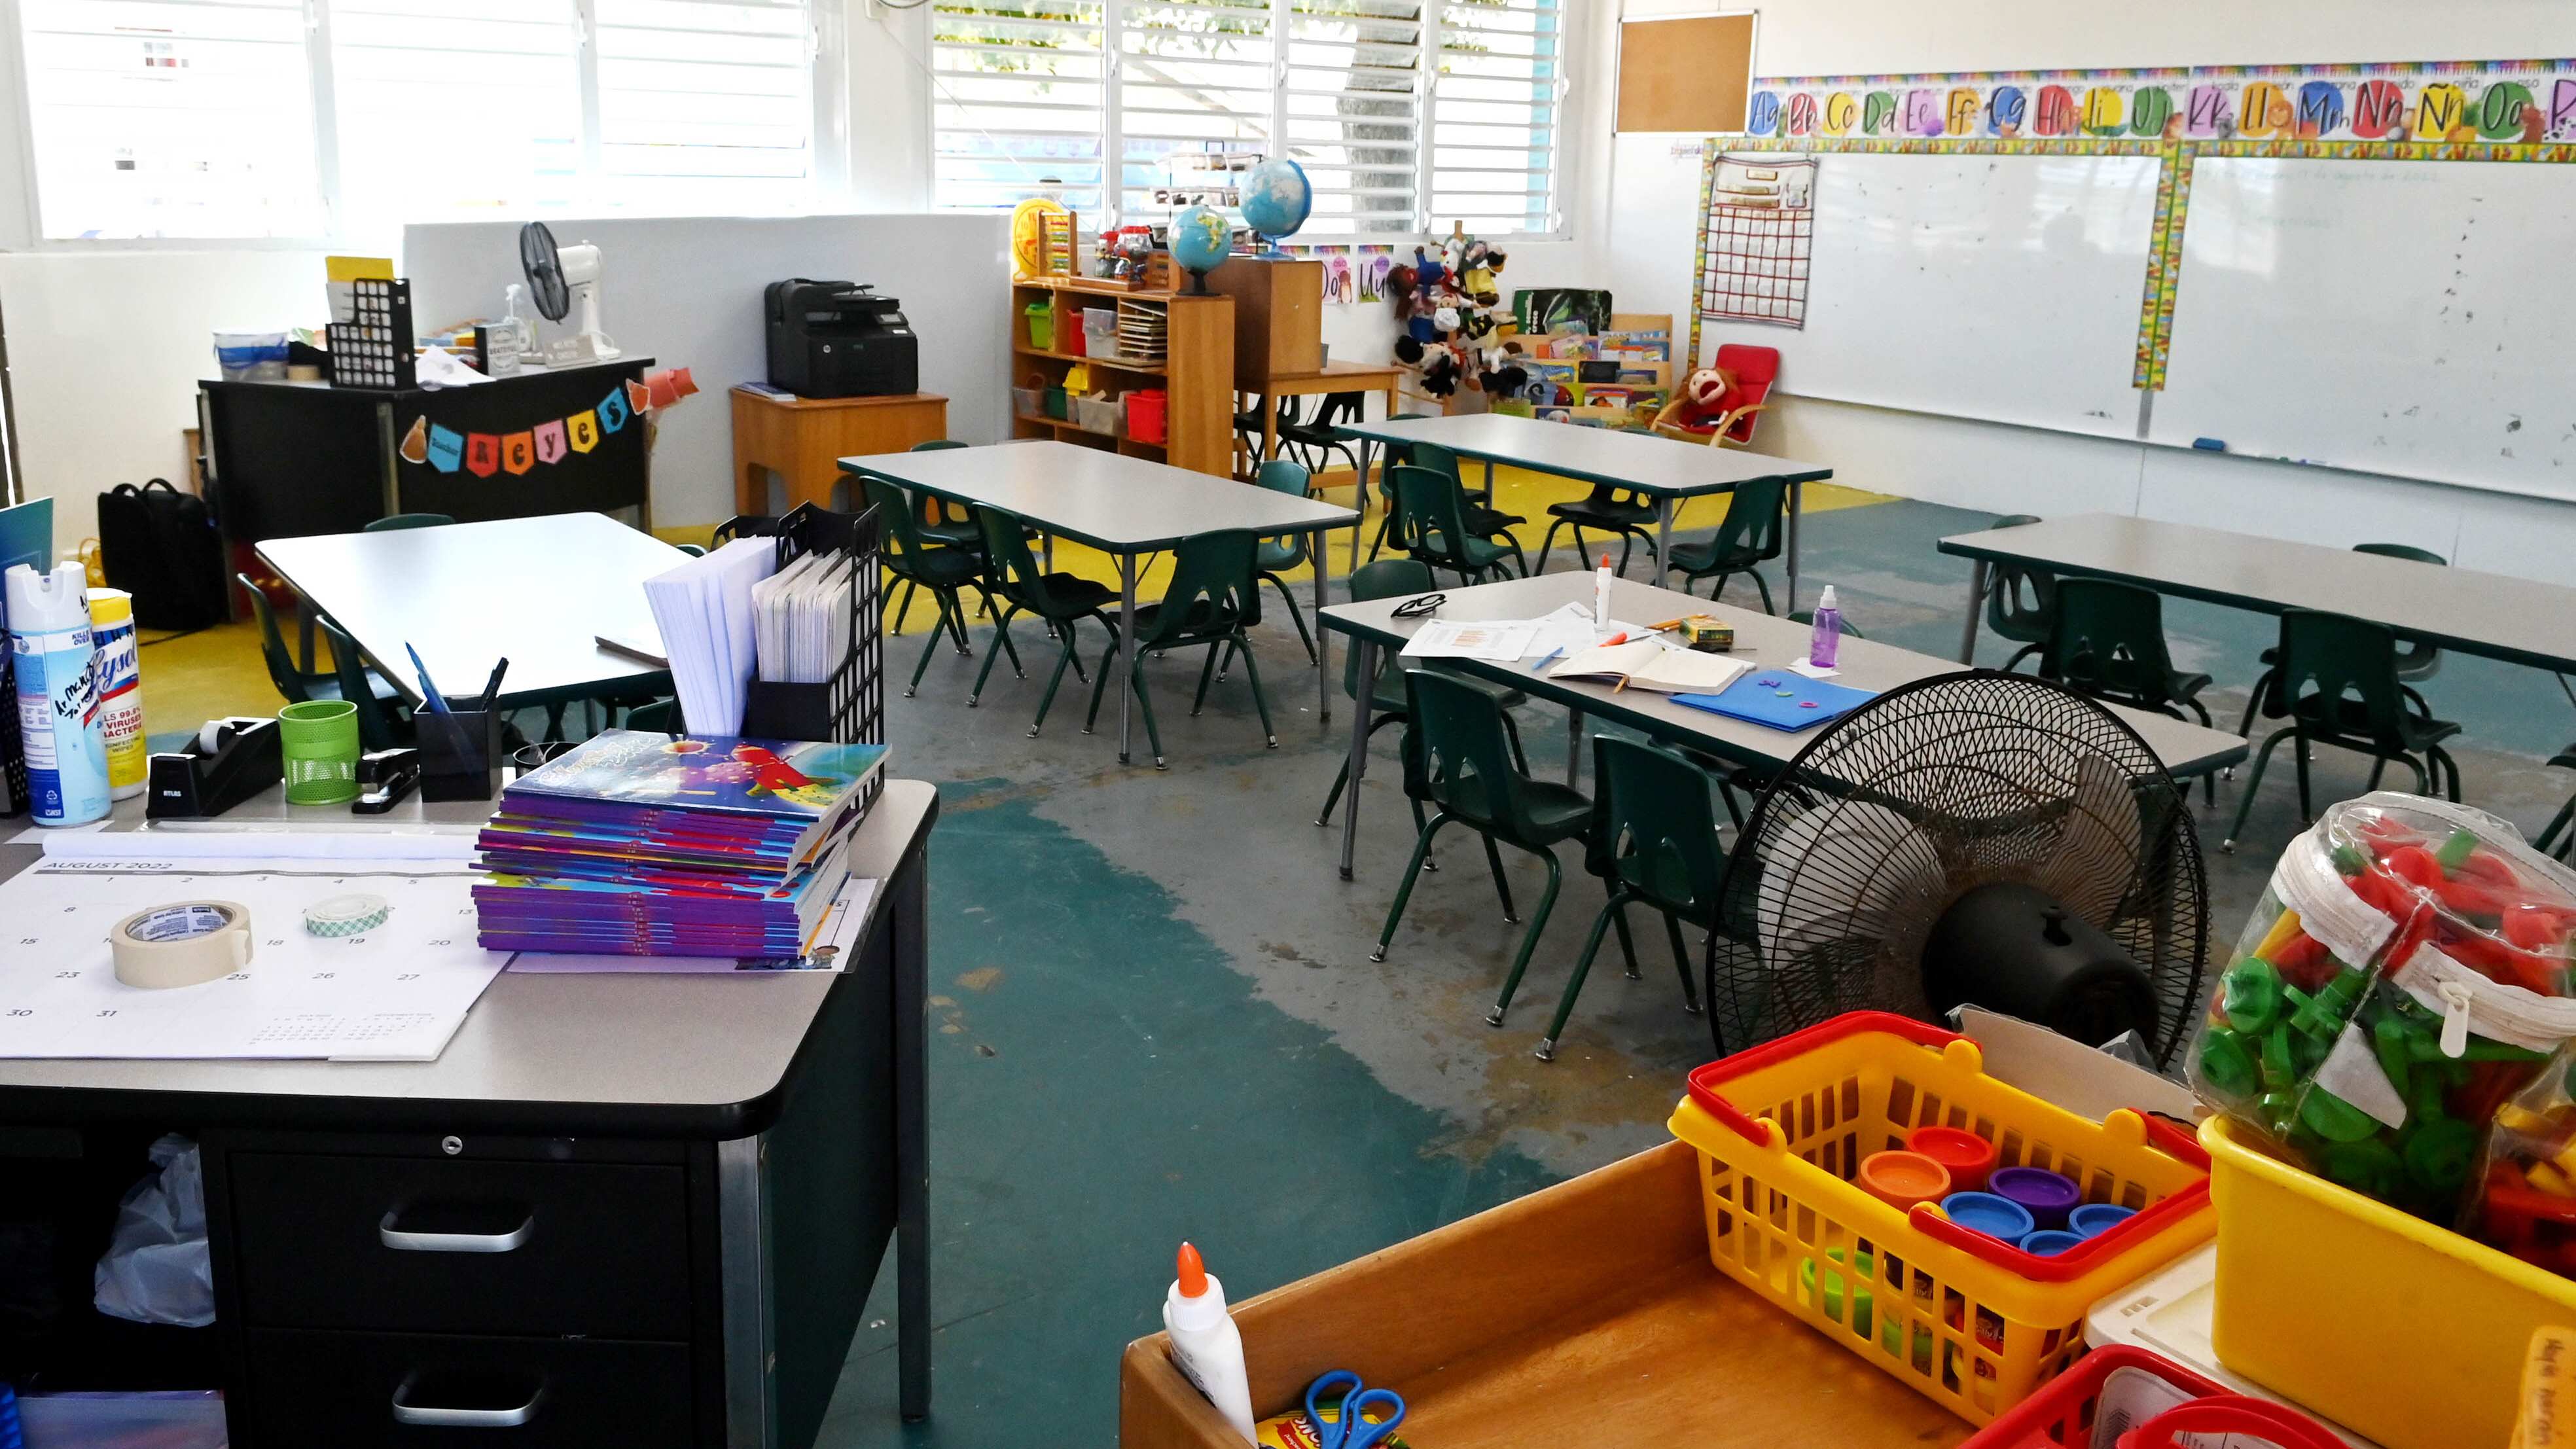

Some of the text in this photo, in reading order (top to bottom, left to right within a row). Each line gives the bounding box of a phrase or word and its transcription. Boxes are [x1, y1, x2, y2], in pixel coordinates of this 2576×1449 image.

[1827, 91, 1853, 131] Cc
[1865, 94, 1899, 133] Dd
[1906, 90, 1931, 132] Ee
[2295, 89, 2350, 135] Mm
[2357, 82, 2403, 129] Nn
[2418, 82, 2464, 132] Ññ
[2482, 82, 2523, 130] Oo
